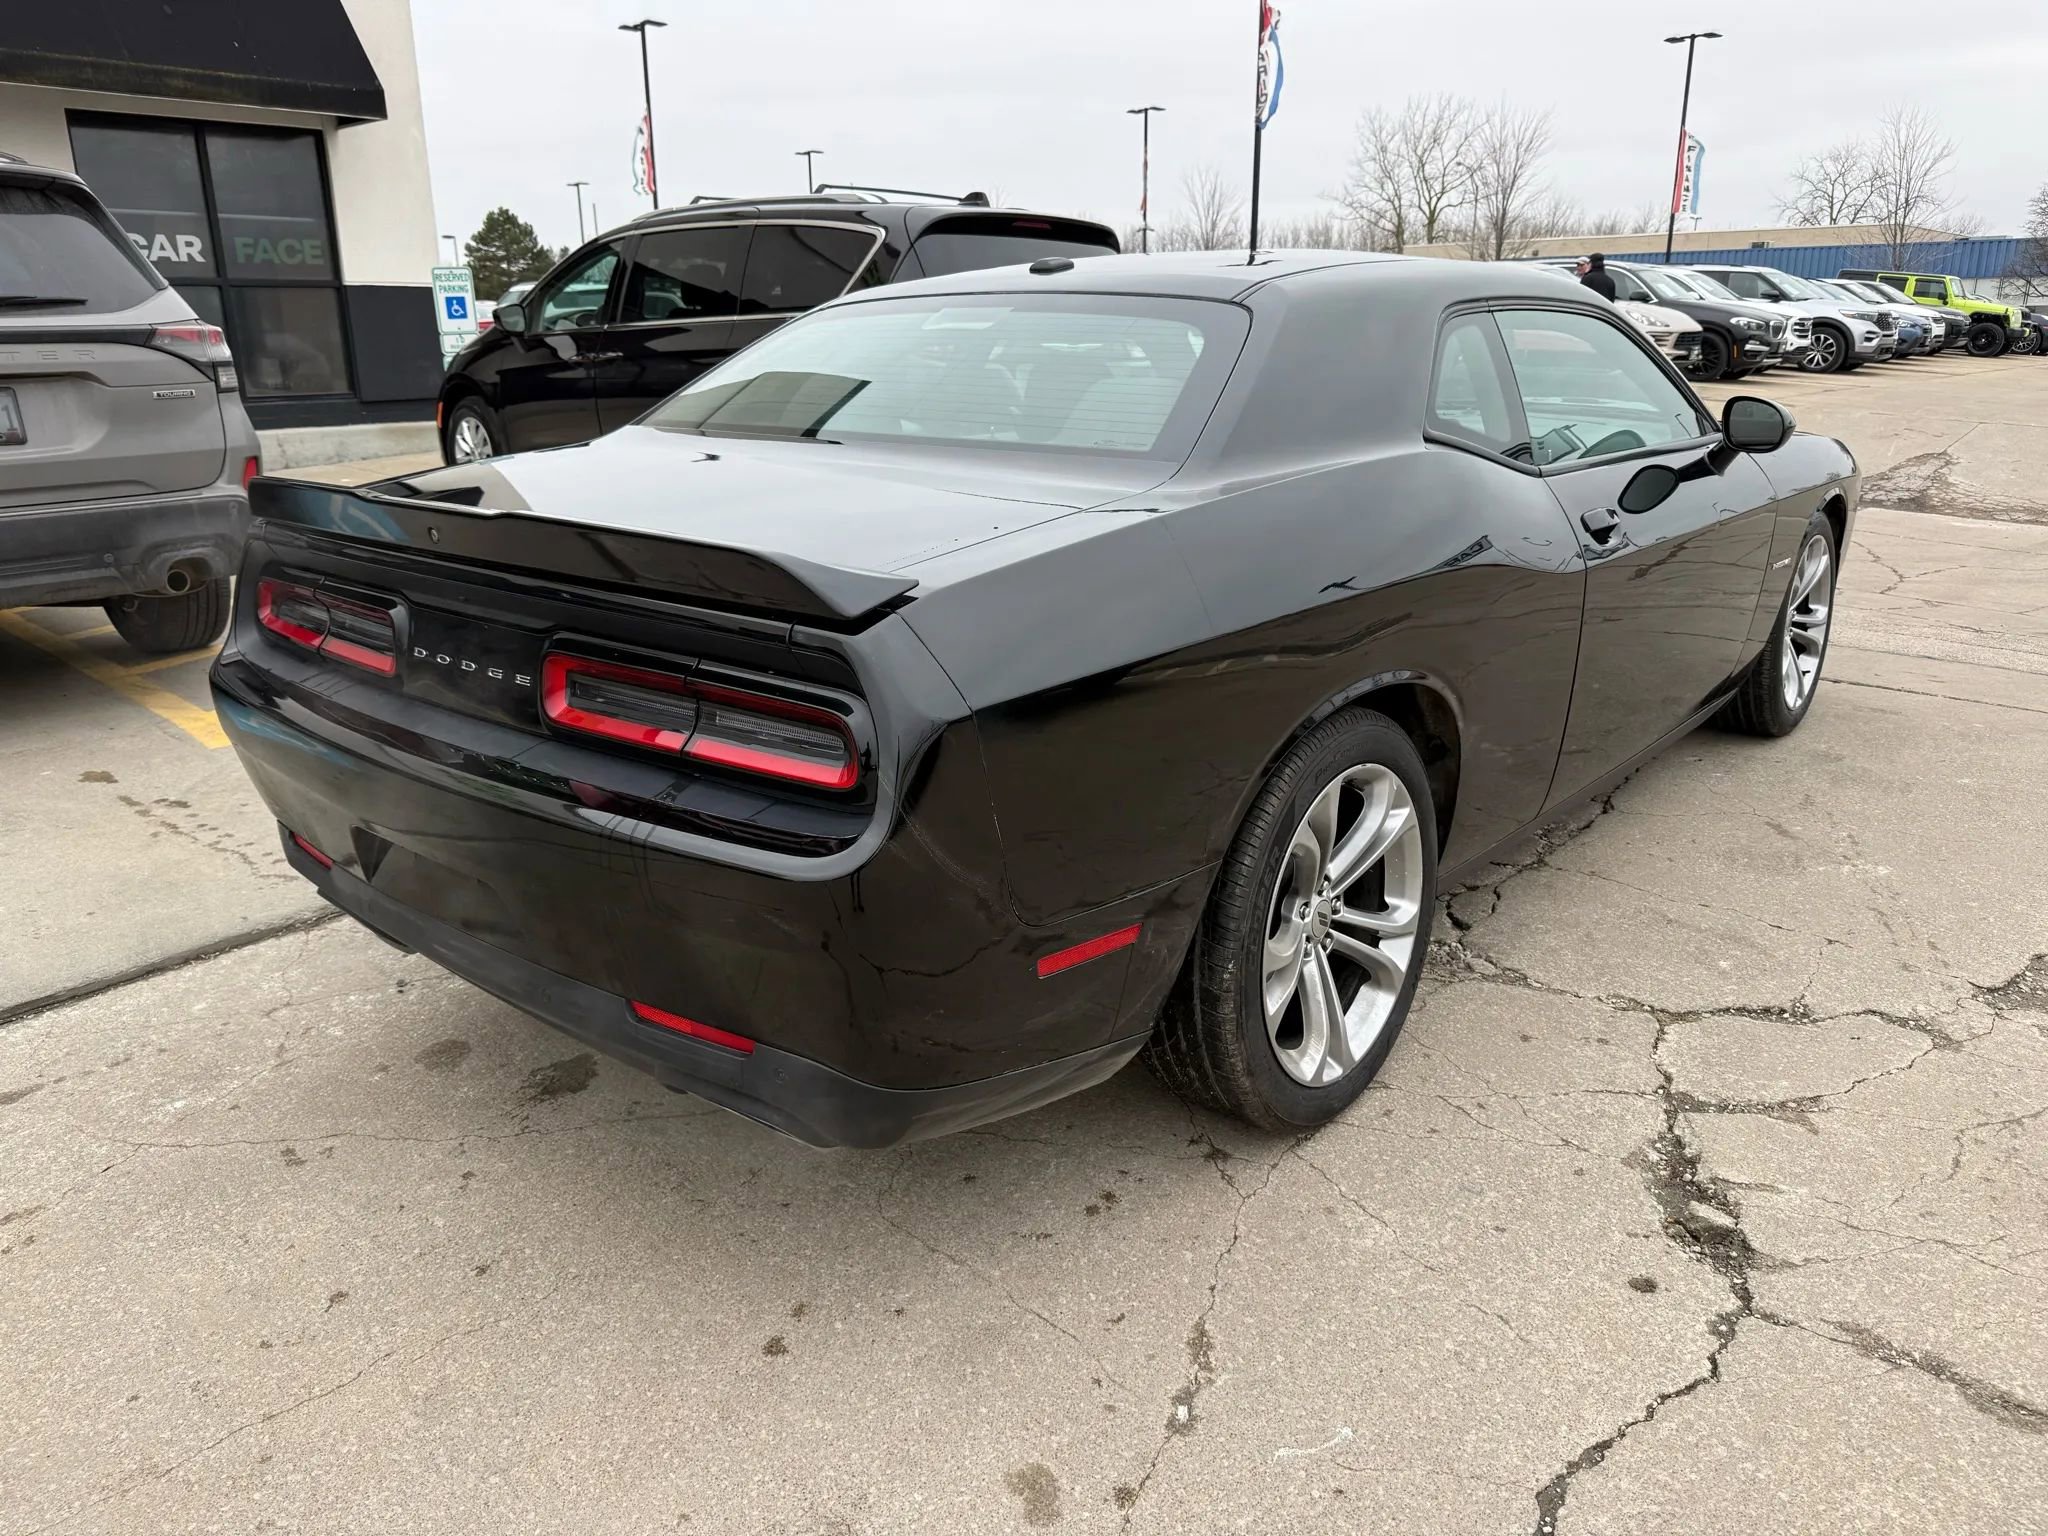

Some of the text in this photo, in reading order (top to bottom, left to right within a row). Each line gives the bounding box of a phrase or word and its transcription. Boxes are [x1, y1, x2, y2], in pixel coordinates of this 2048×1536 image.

[234, 237, 324, 265] FACE
[434, 274, 470, 282] RESERVED
[439, 284, 469, 293] PARKING
[413, 646, 531, 687] DODGE
